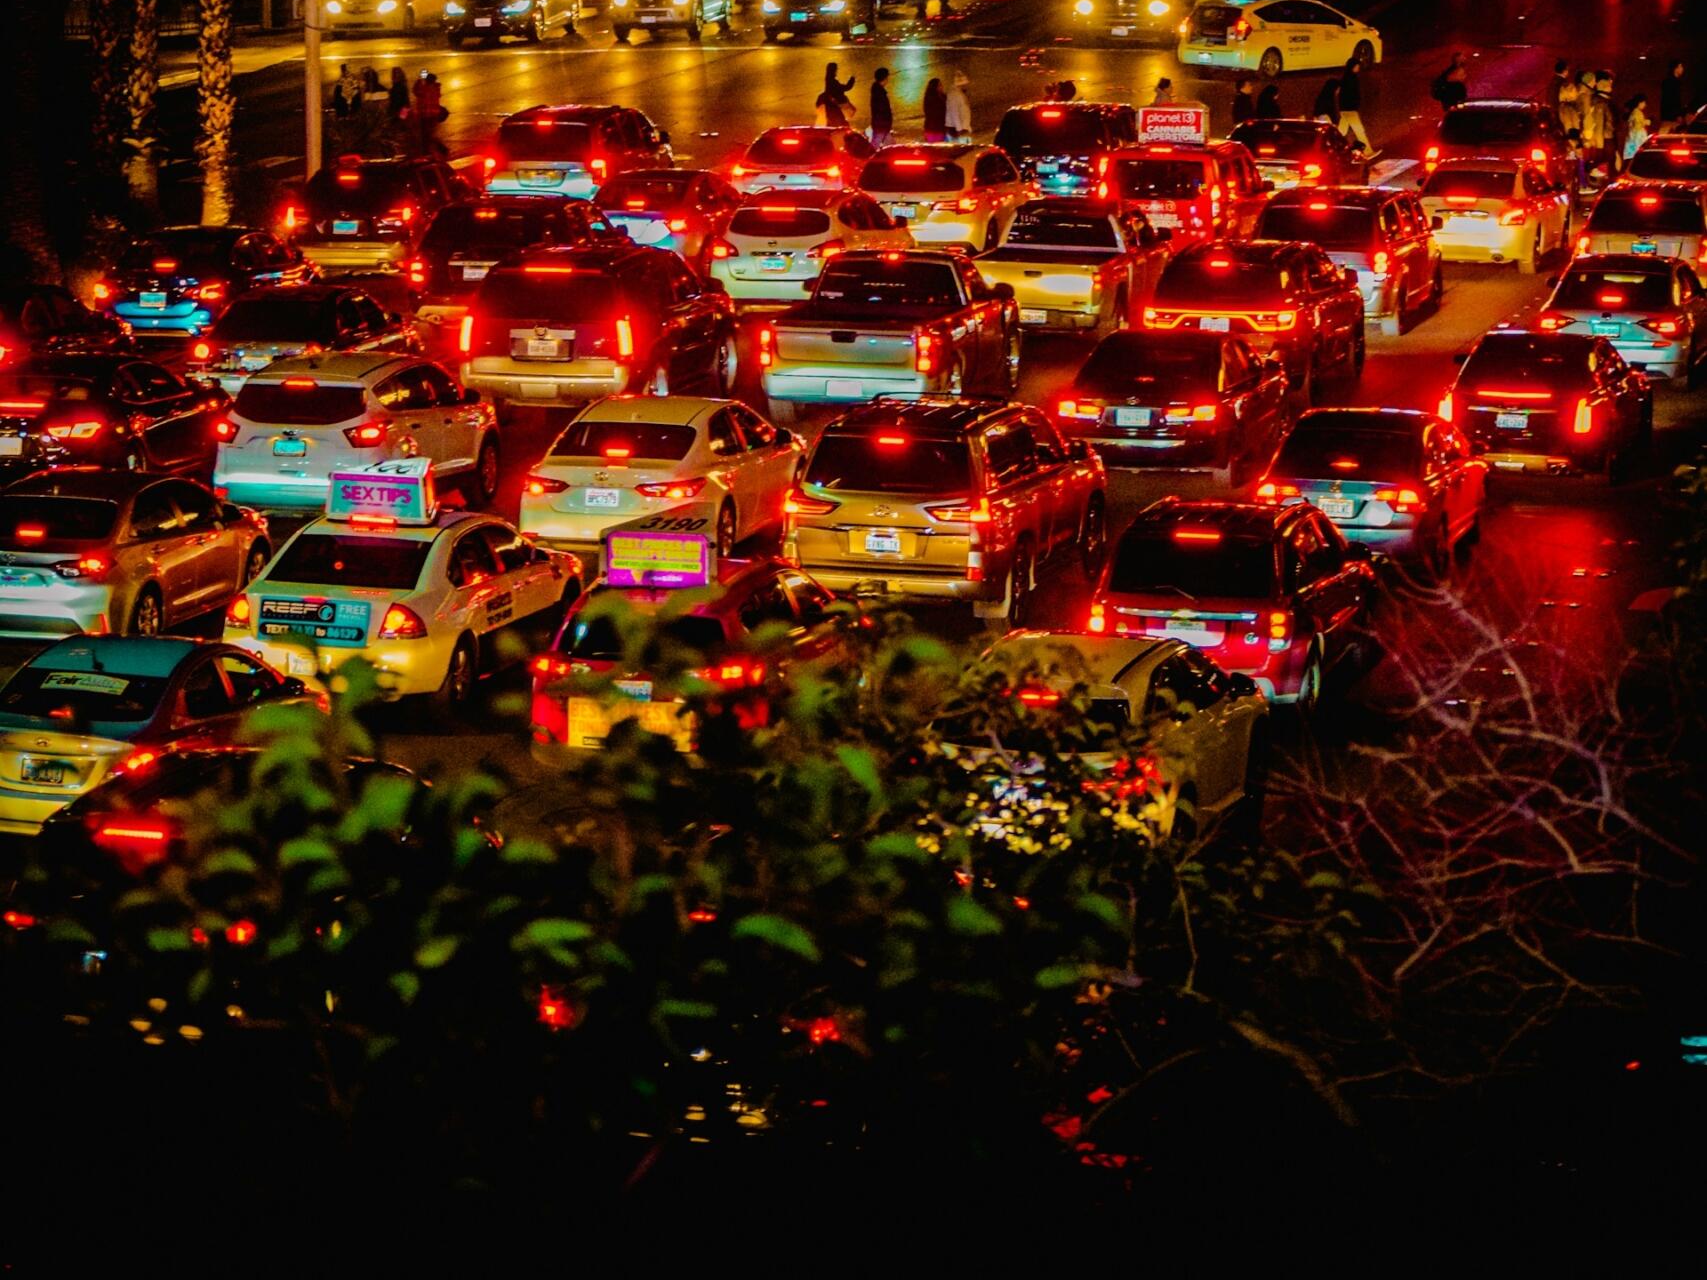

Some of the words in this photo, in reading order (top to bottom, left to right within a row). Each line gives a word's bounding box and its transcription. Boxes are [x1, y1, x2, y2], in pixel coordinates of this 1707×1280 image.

[1146, 113, 1181, 125] planet
[340, 484, 375, 503] SEX
[376, 486, 412, 505] TIPS
[640, 517, 708, 531] 3190
[262, 600, 321, 614] REEF
[339, 604, 368, 616] FREE
[265, 623, 290, 634] TEXT
[315, 627, 326, 637] to
